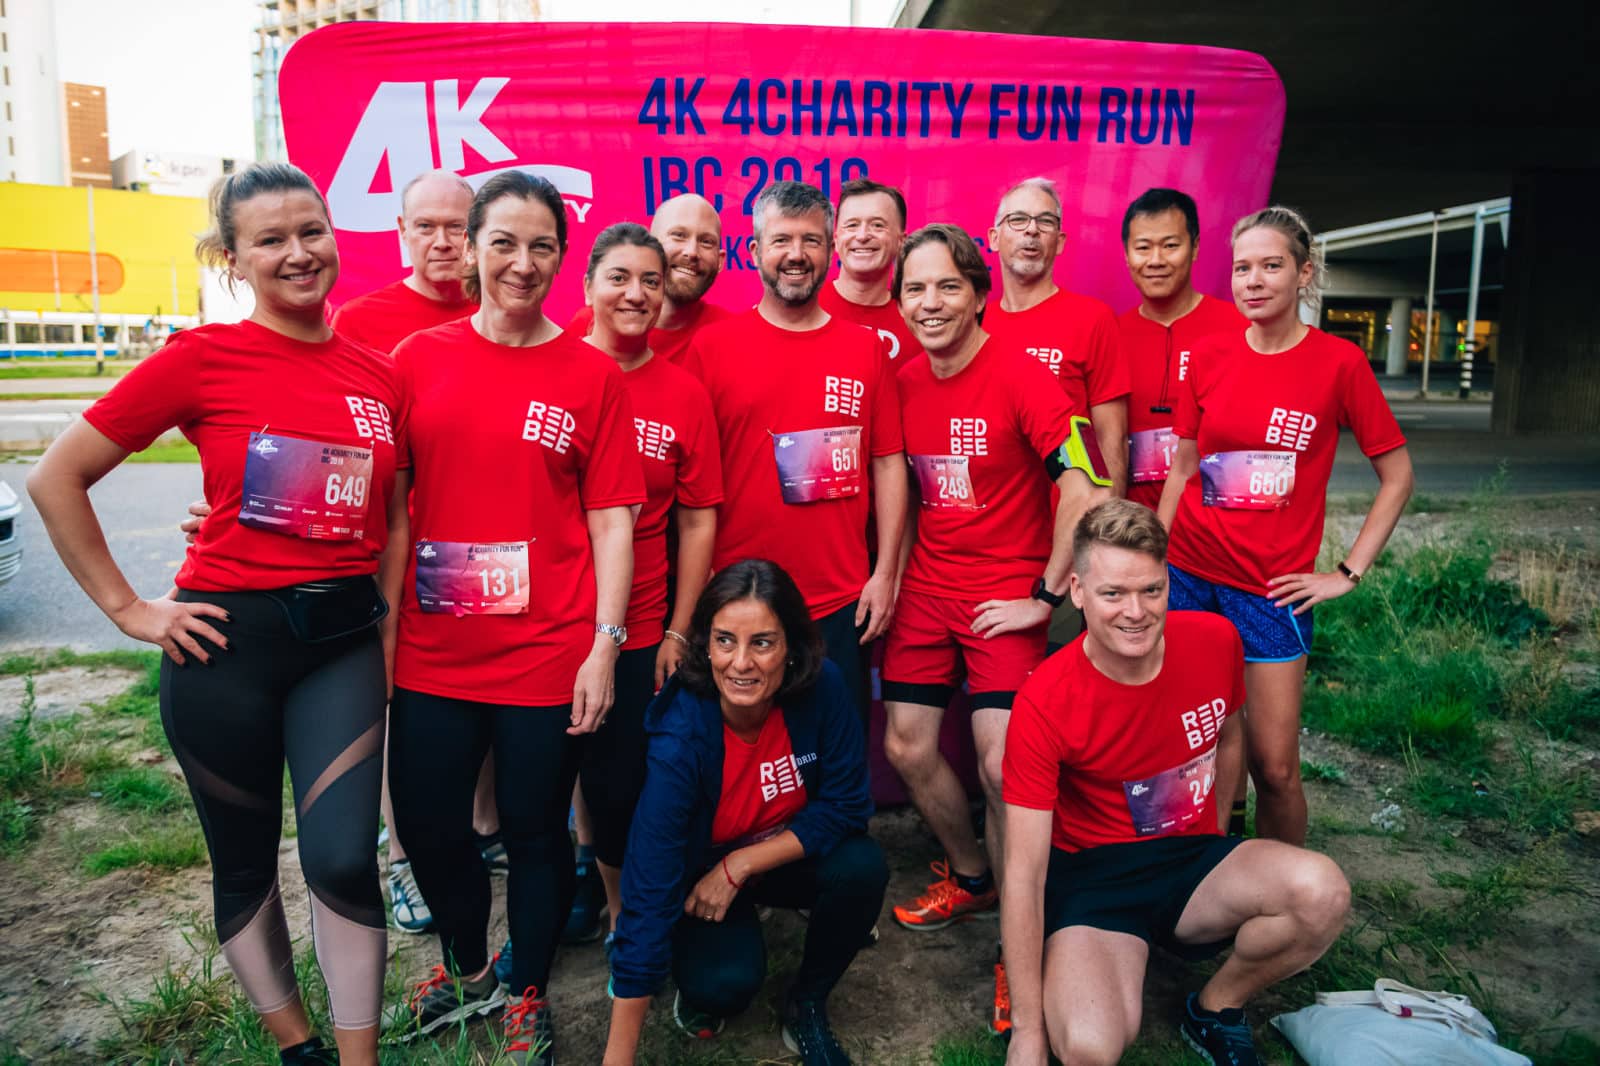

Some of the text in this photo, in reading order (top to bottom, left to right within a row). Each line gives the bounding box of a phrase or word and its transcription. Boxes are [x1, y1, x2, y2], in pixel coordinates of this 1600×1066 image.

[638, 77, 1195, 146] 4K 4CHARITY FUN RUN
[643, 156, 723, 216] IBC
[825, 375, 864, 398] RED
[345, 396, 390, 423] RED
[527, 400, 576, 433] RED
[824, 394, 861, 418] BEE
[353, 416, 394, 445] BEE
[950, 418, 987, 436] RED
[1269, 407, 1317, 433] RED
[522, 418, 572, 455] BEE
[950, 437, 988, 456] BEE
[1265, 425, 1311, 451] BEE
[831, 447, 857, 472] 651
[325, 473, 366, 507] 649
[937, 476, 969, 499] 248
[1249, 471, 1289, 496] 650
[479, 567, 520, 597] 131
[1181, 698, 1226, 731] RED
